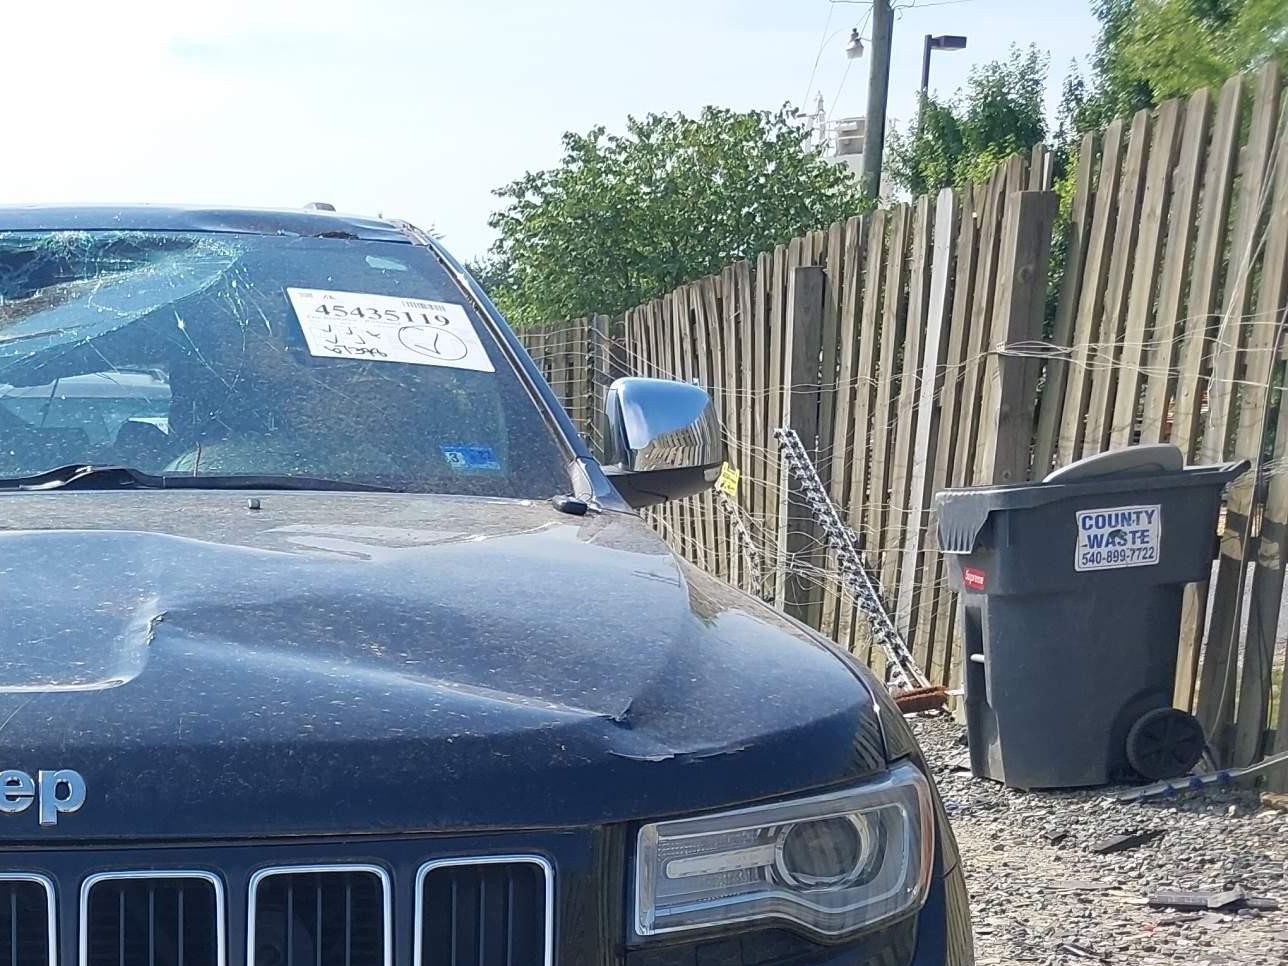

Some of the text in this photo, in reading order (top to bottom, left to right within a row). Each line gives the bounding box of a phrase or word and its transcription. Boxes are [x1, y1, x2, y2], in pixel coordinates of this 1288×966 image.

[315, 304, 450, 326] 45435119
[1081, 509, 1155, 531] COUNTY
[1087, 529, 1150, 549] WASTE
[1081, 546, 1155, 566] 540-899-7722
